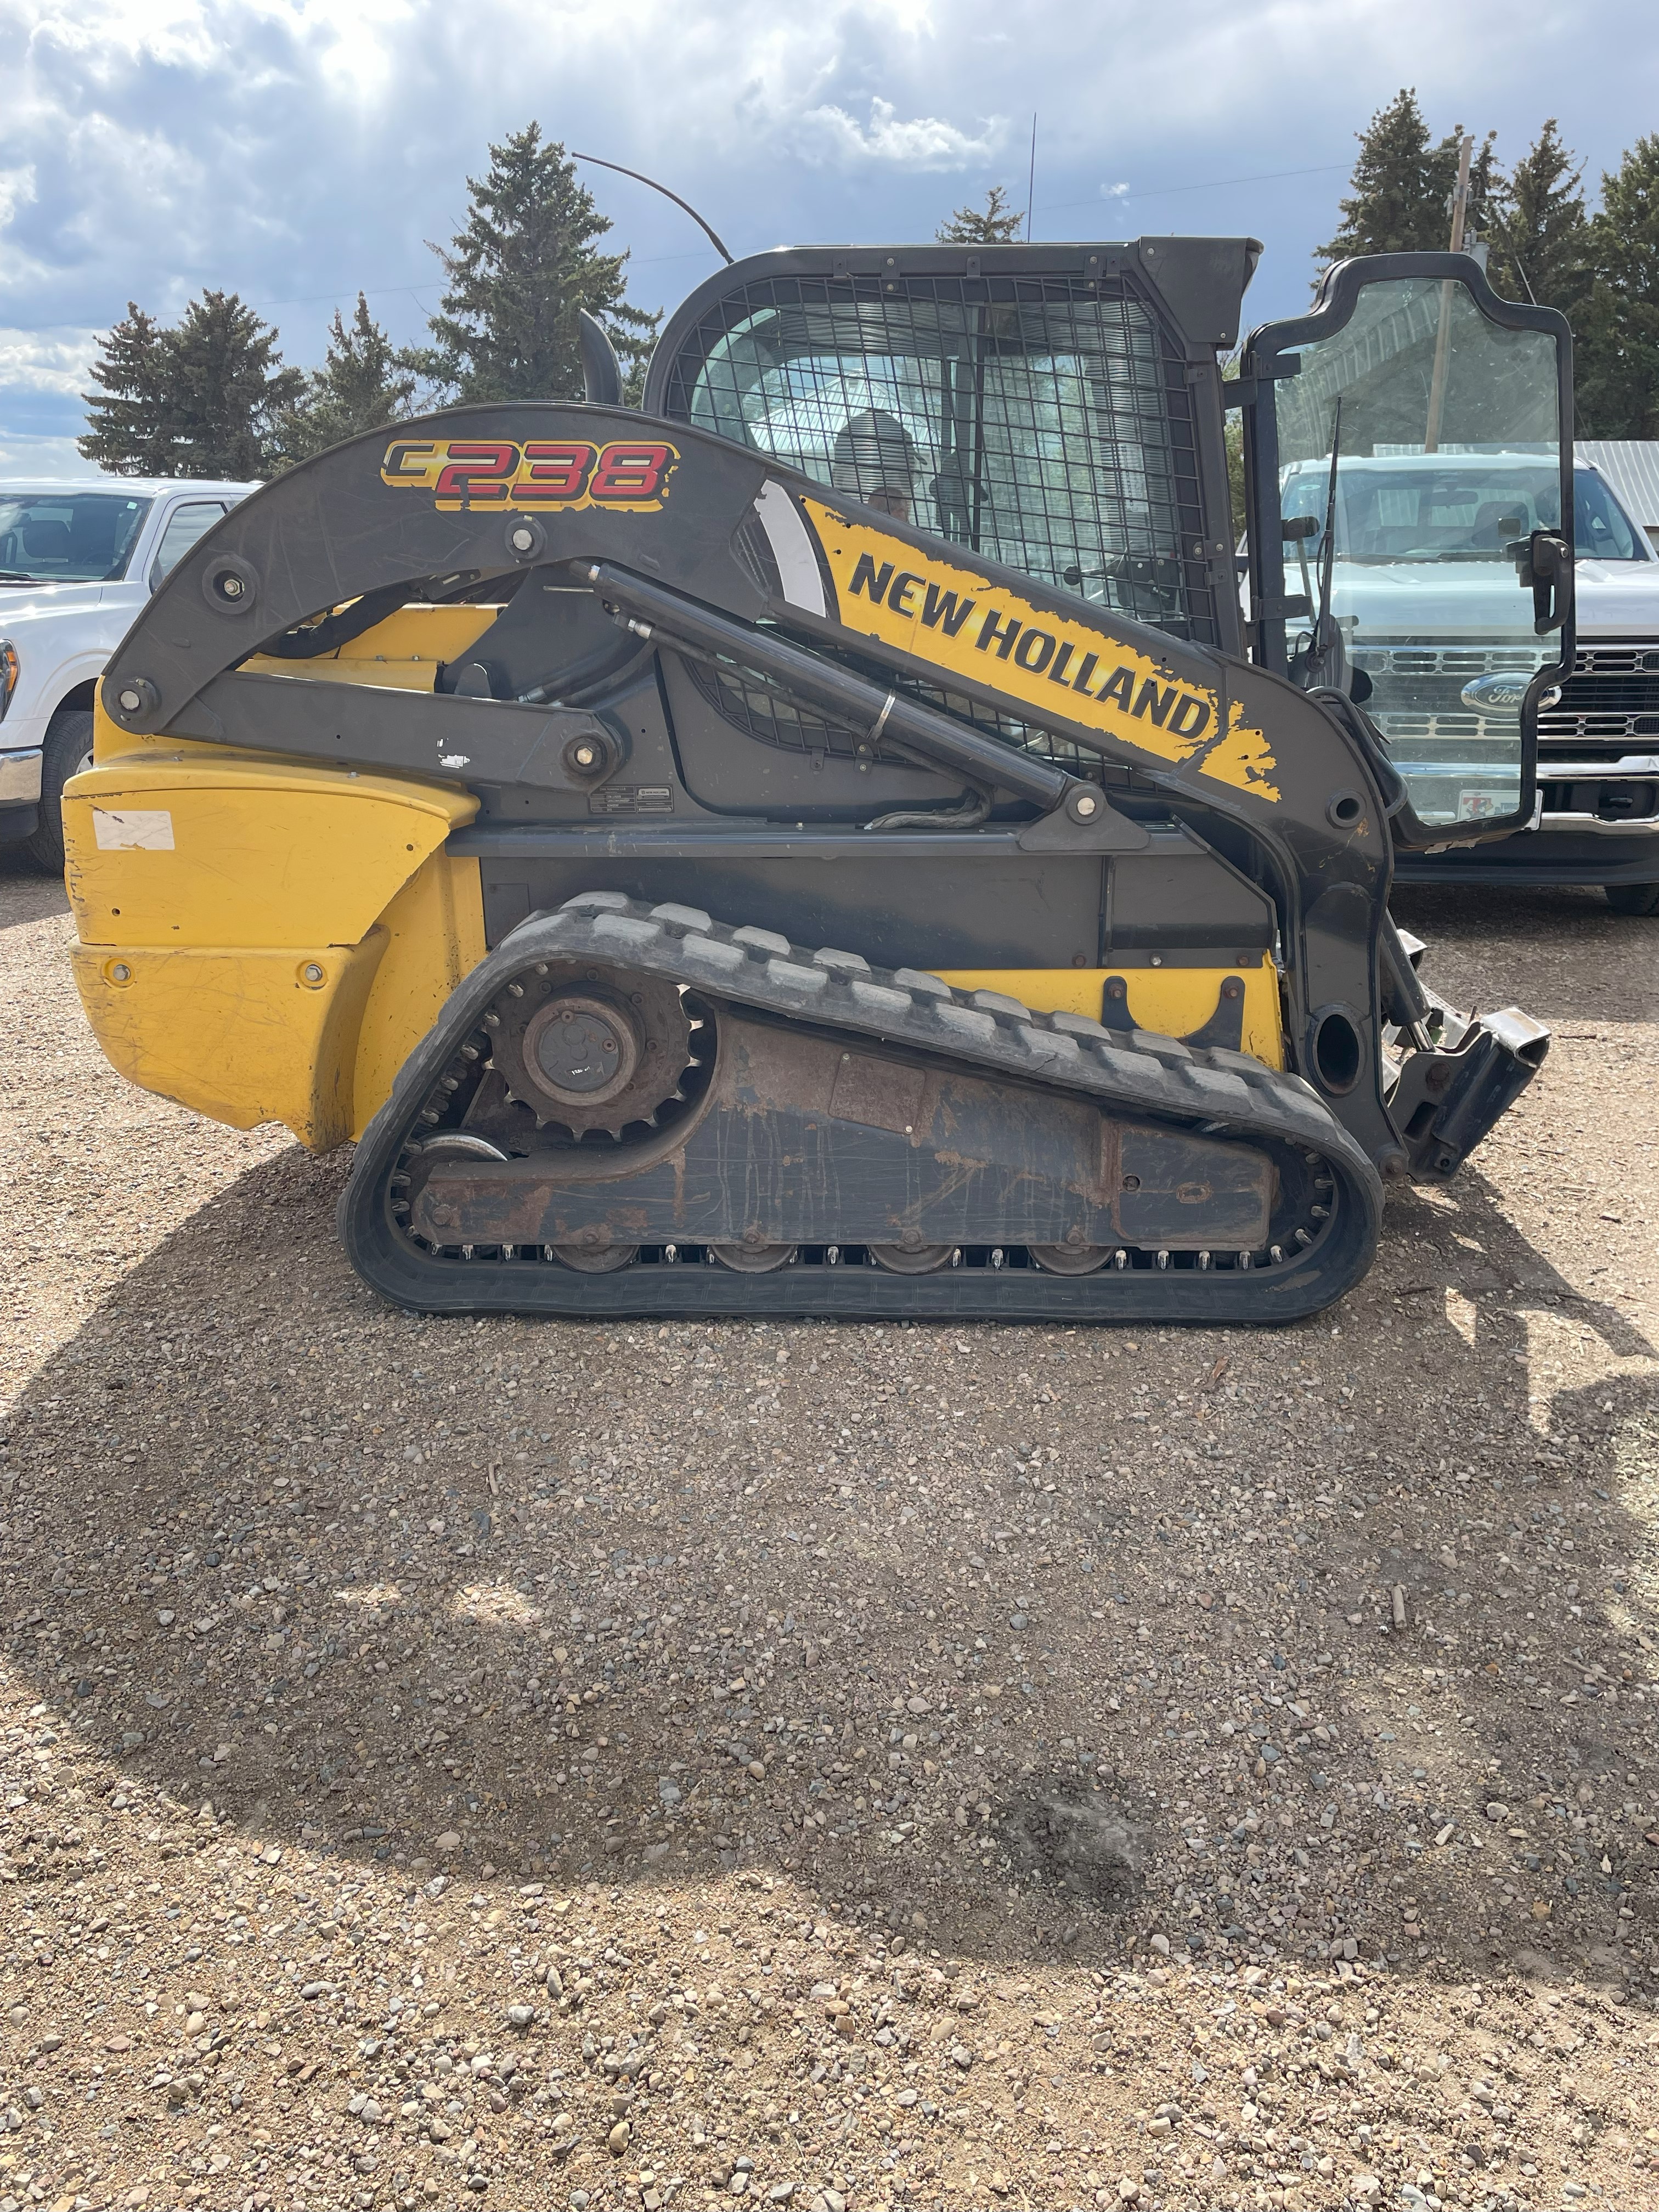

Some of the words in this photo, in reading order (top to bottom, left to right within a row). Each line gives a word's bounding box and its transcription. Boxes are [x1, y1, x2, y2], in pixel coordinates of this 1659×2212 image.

[383, 442, 674, 502] C238
[848, 551, 976, 637] NEW
[975, 608, 1211, 740] HOLLAND
[1488, 685, 1526, 703] For
